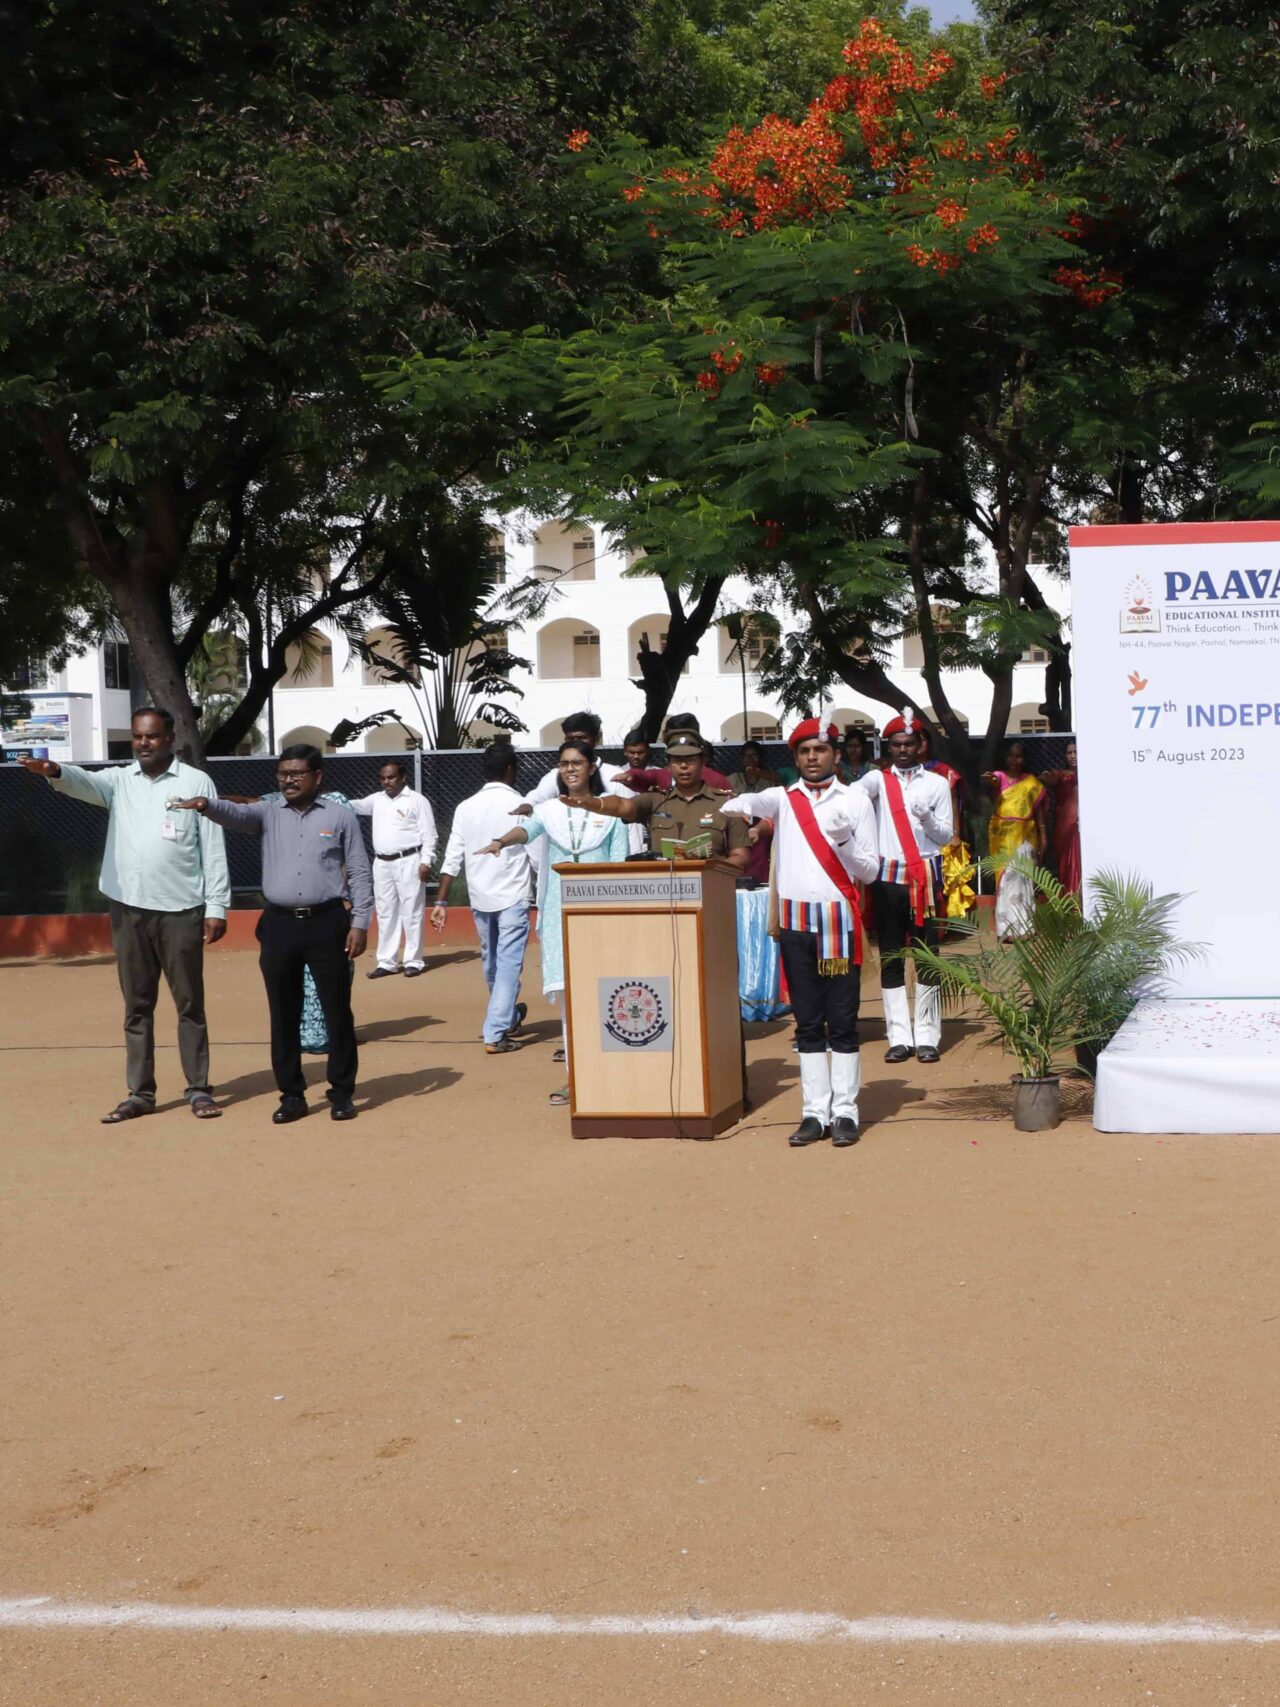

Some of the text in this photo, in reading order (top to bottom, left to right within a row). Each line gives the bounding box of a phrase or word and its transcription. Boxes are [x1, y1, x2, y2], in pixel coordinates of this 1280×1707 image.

[1165, 611, 1238, 620] EDUCATIONAL
[1166, 624, 1191, 633] Think
[1253, 621, 1279, 631] Think
[1148, 640, 1173, 648] Paavai
[1269, 636, 1280, 645] TN
[1156, 749, 1206, 766] August
[1210, 747, 1245, 761] 2023
[566, 882, 696, 896] PAAVAI ENGINEERING COLLEGE
